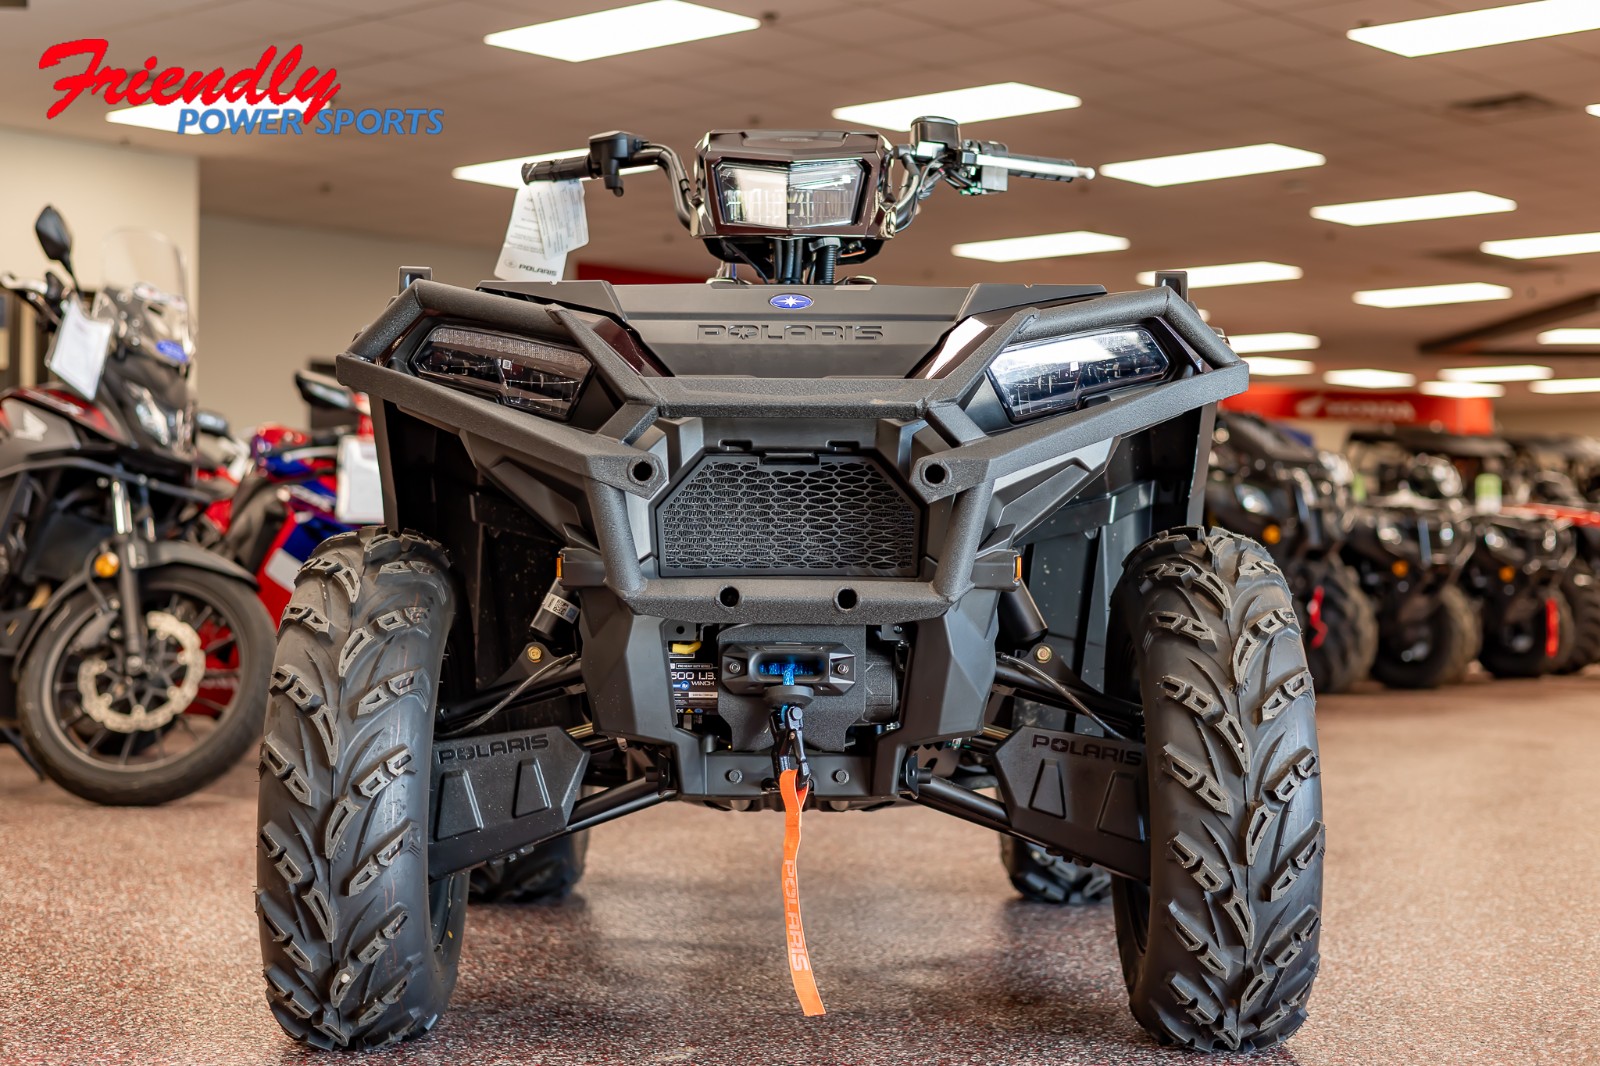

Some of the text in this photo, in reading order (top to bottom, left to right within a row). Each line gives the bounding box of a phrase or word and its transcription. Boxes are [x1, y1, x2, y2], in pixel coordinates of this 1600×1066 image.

[518, 263, 558, 277] POLARIS
[697, 324, 884, 341] POLARIS
[438, 733, 549, 765] POLARIS
[1032, 734, 1142, 766] POLARIS
[784, 859, 809, 972] POLARIS
